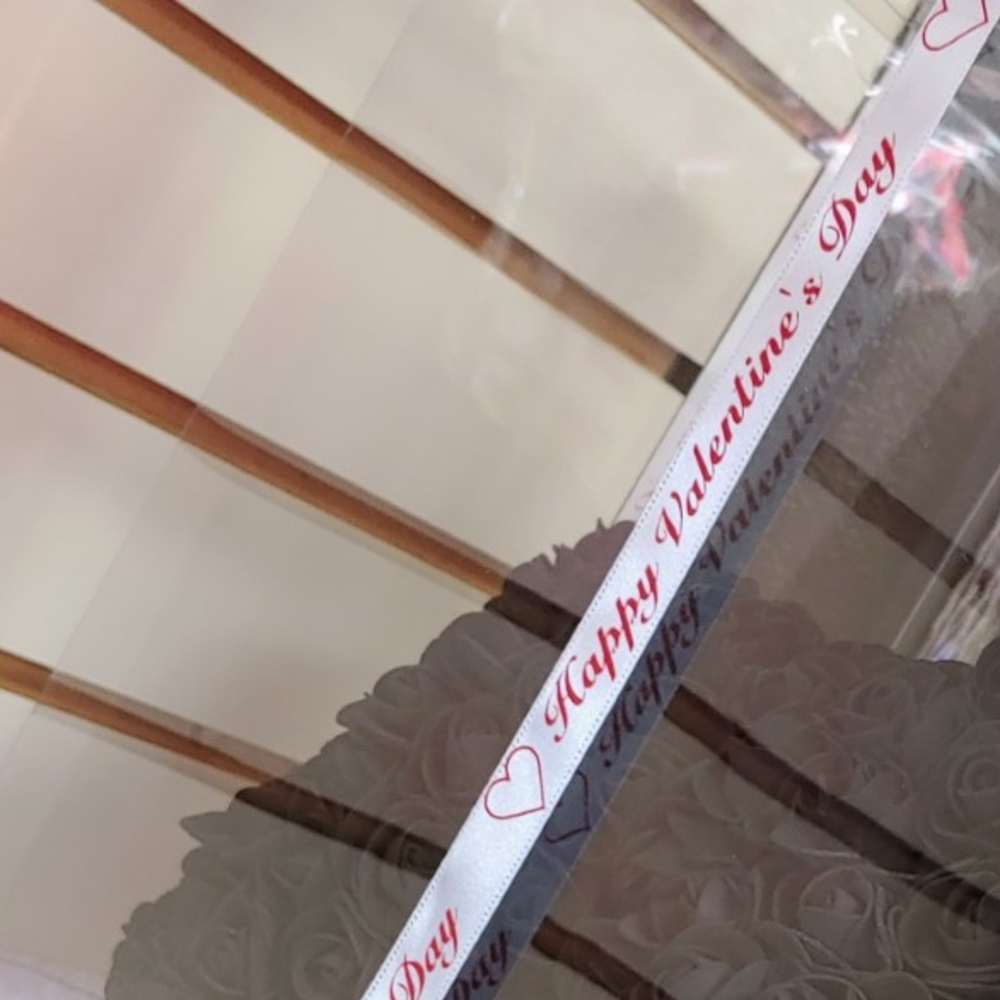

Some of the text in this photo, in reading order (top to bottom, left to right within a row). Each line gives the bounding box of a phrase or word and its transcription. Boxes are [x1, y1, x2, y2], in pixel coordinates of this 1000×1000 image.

[544, 129, 896, 743] Happy Valentine's Day
